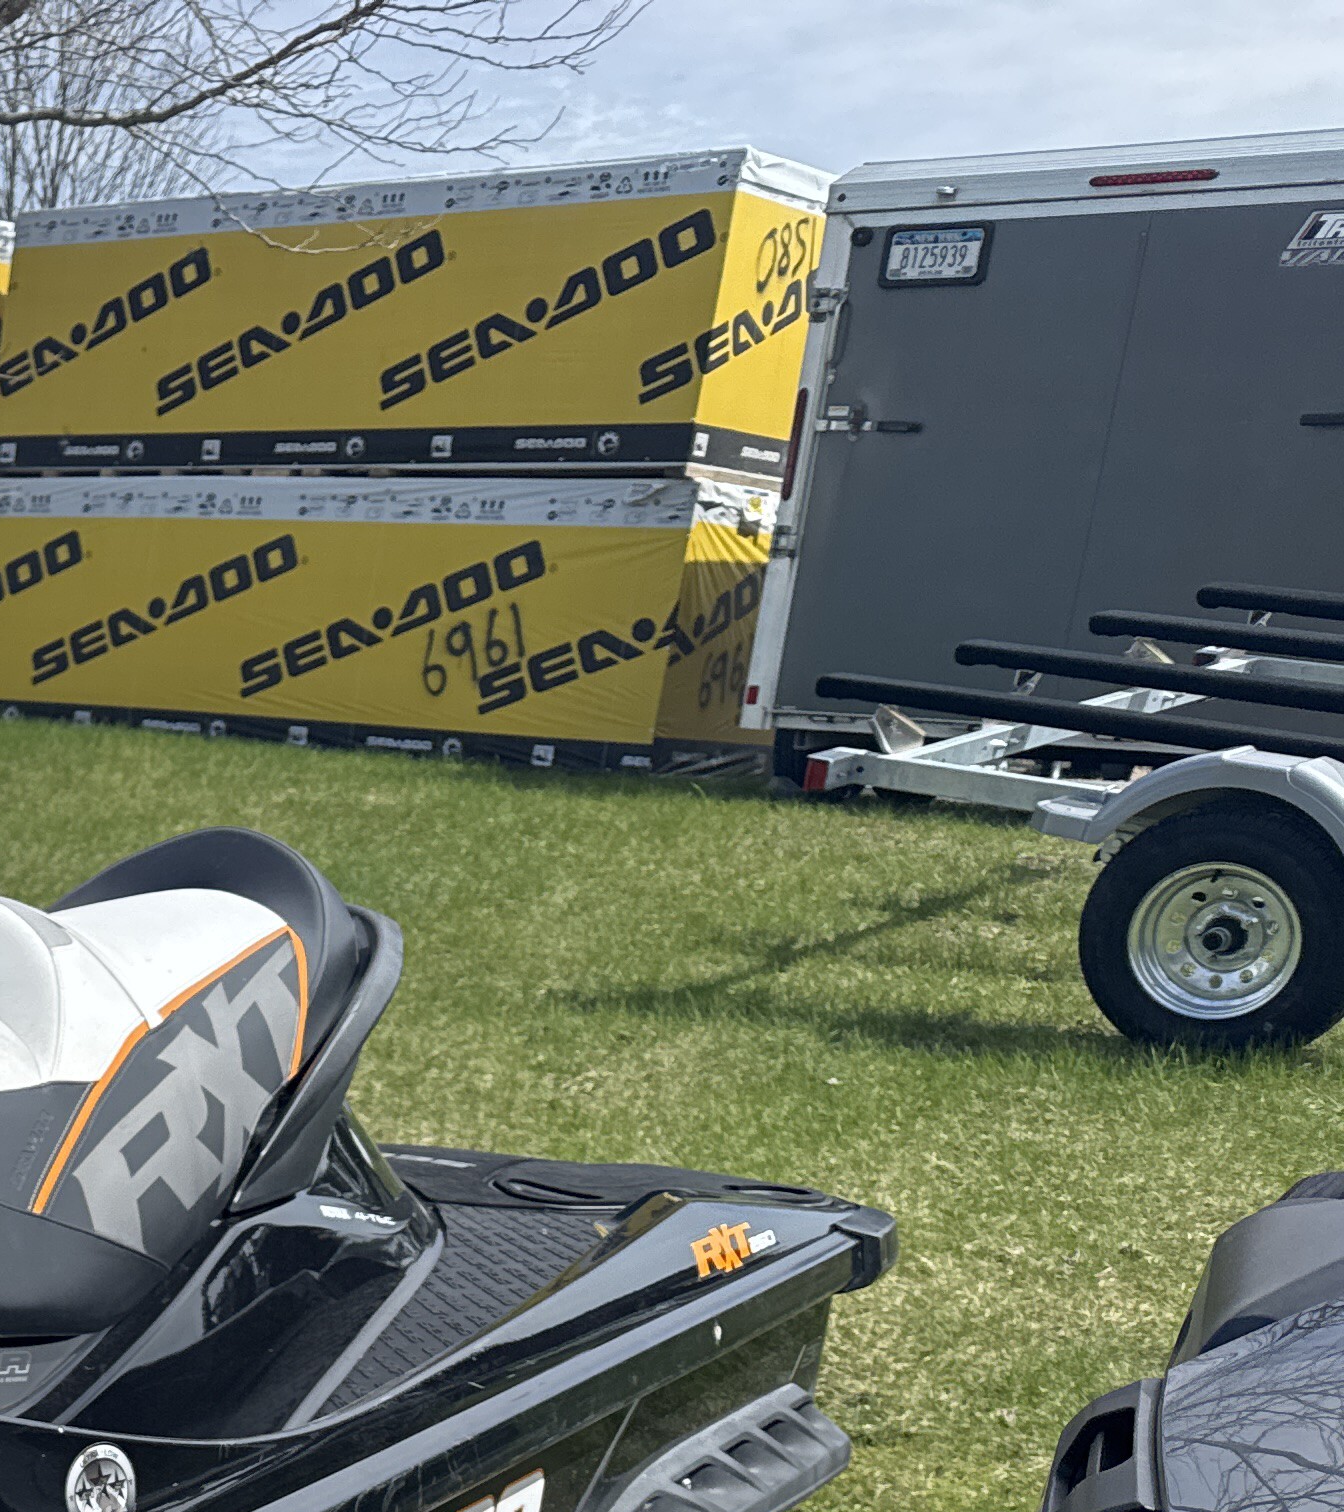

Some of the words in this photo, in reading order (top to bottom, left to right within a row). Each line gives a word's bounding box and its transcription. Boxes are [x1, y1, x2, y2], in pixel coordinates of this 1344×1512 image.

[900, 244, 968, 270] 8125939
[421, 601, 526, 697] 6961
[72, 938, 301, 1254] RXT
[690, 1221, 752, 1278] RXT
